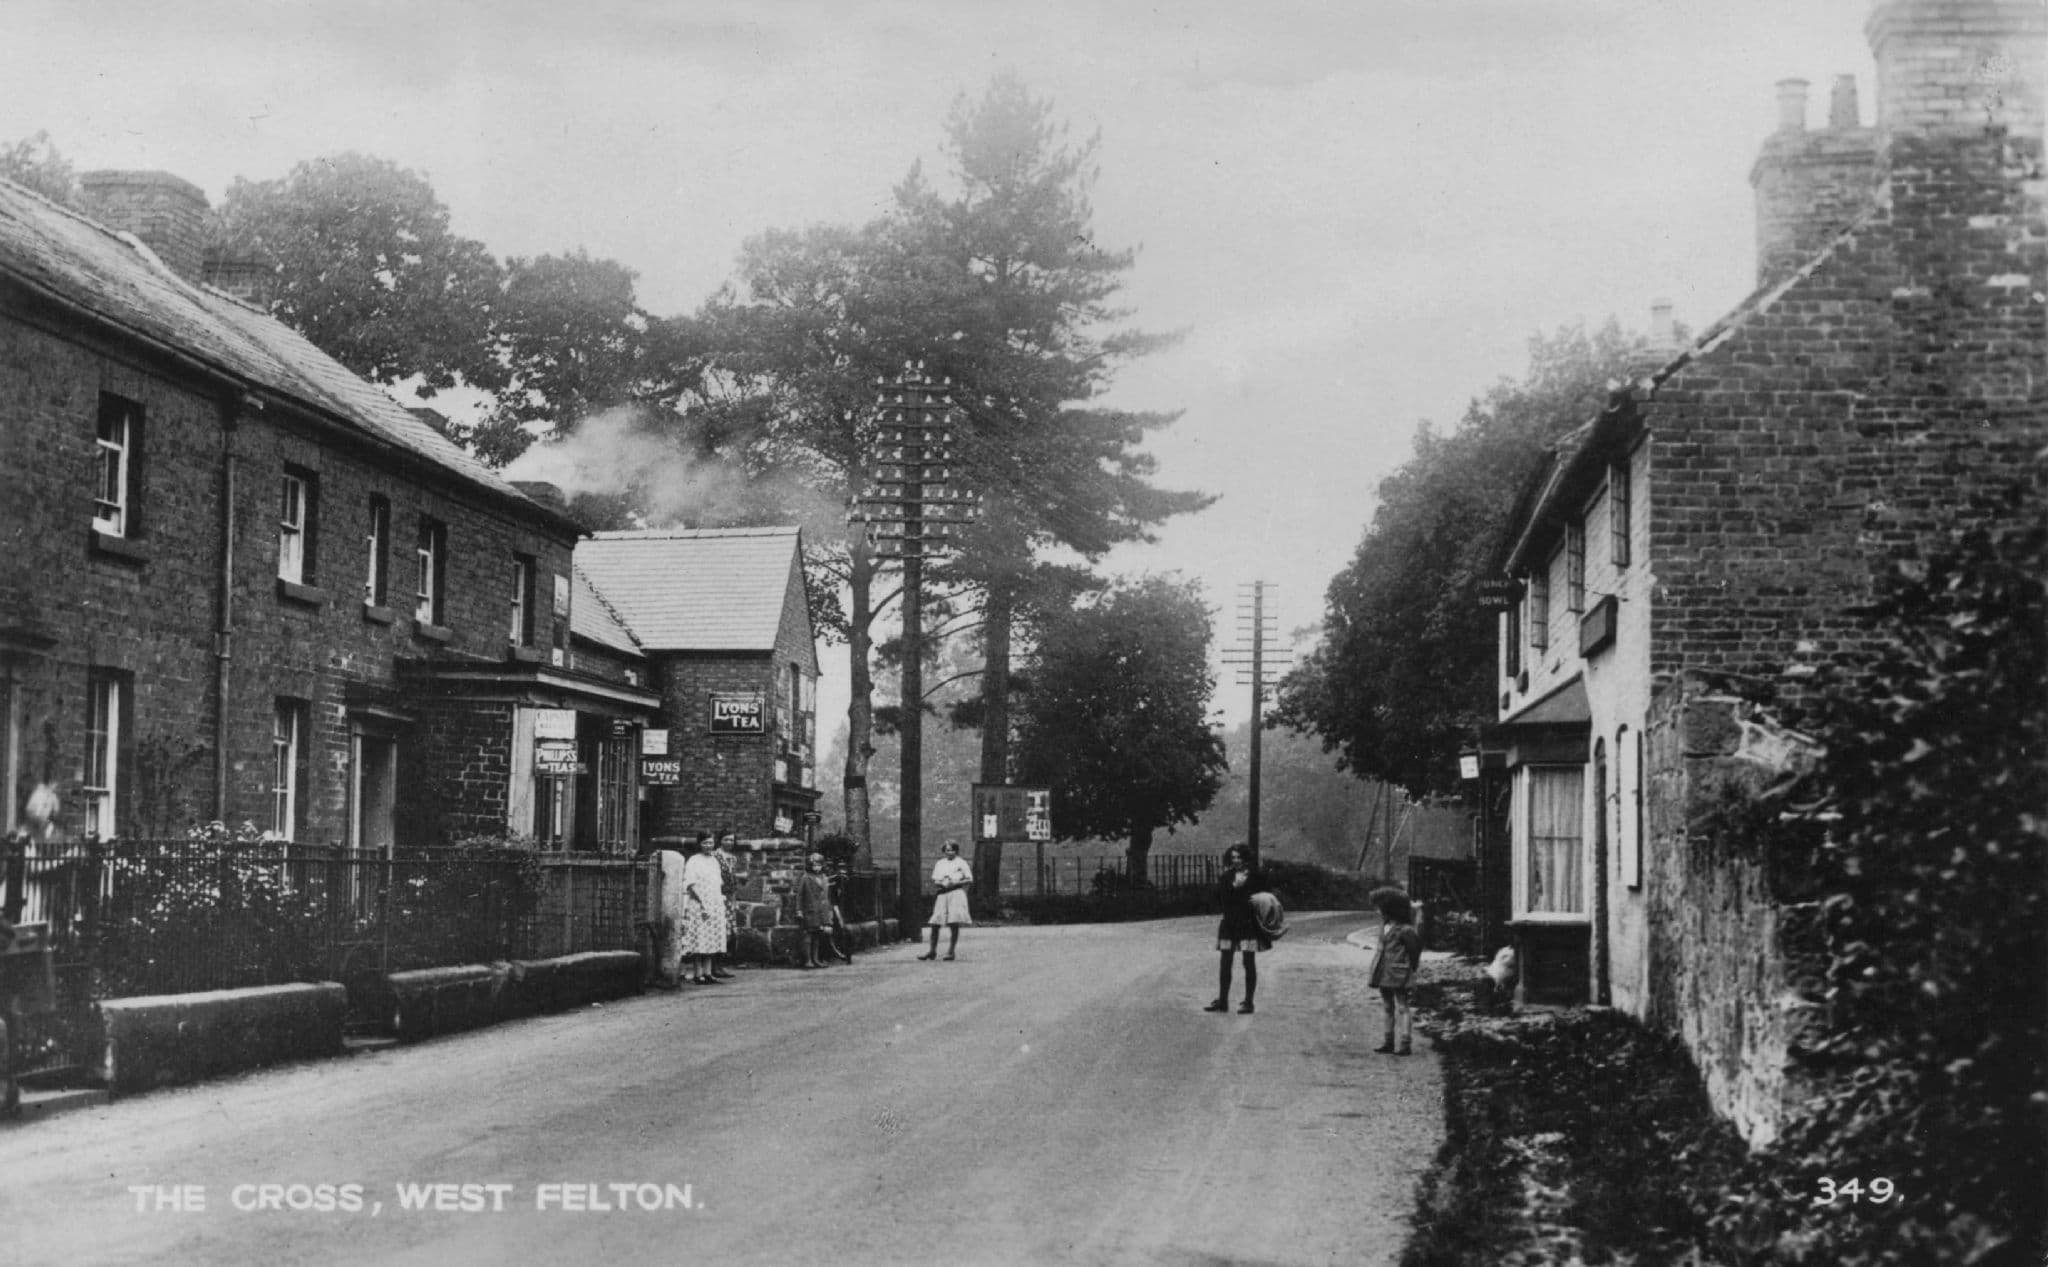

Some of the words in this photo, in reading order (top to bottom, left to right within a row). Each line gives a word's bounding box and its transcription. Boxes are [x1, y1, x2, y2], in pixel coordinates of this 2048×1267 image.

[729, 714, 760, 728] TEA
[548, 762, 578, 773] TEAS
[658, 772, 680, 781] TEA
